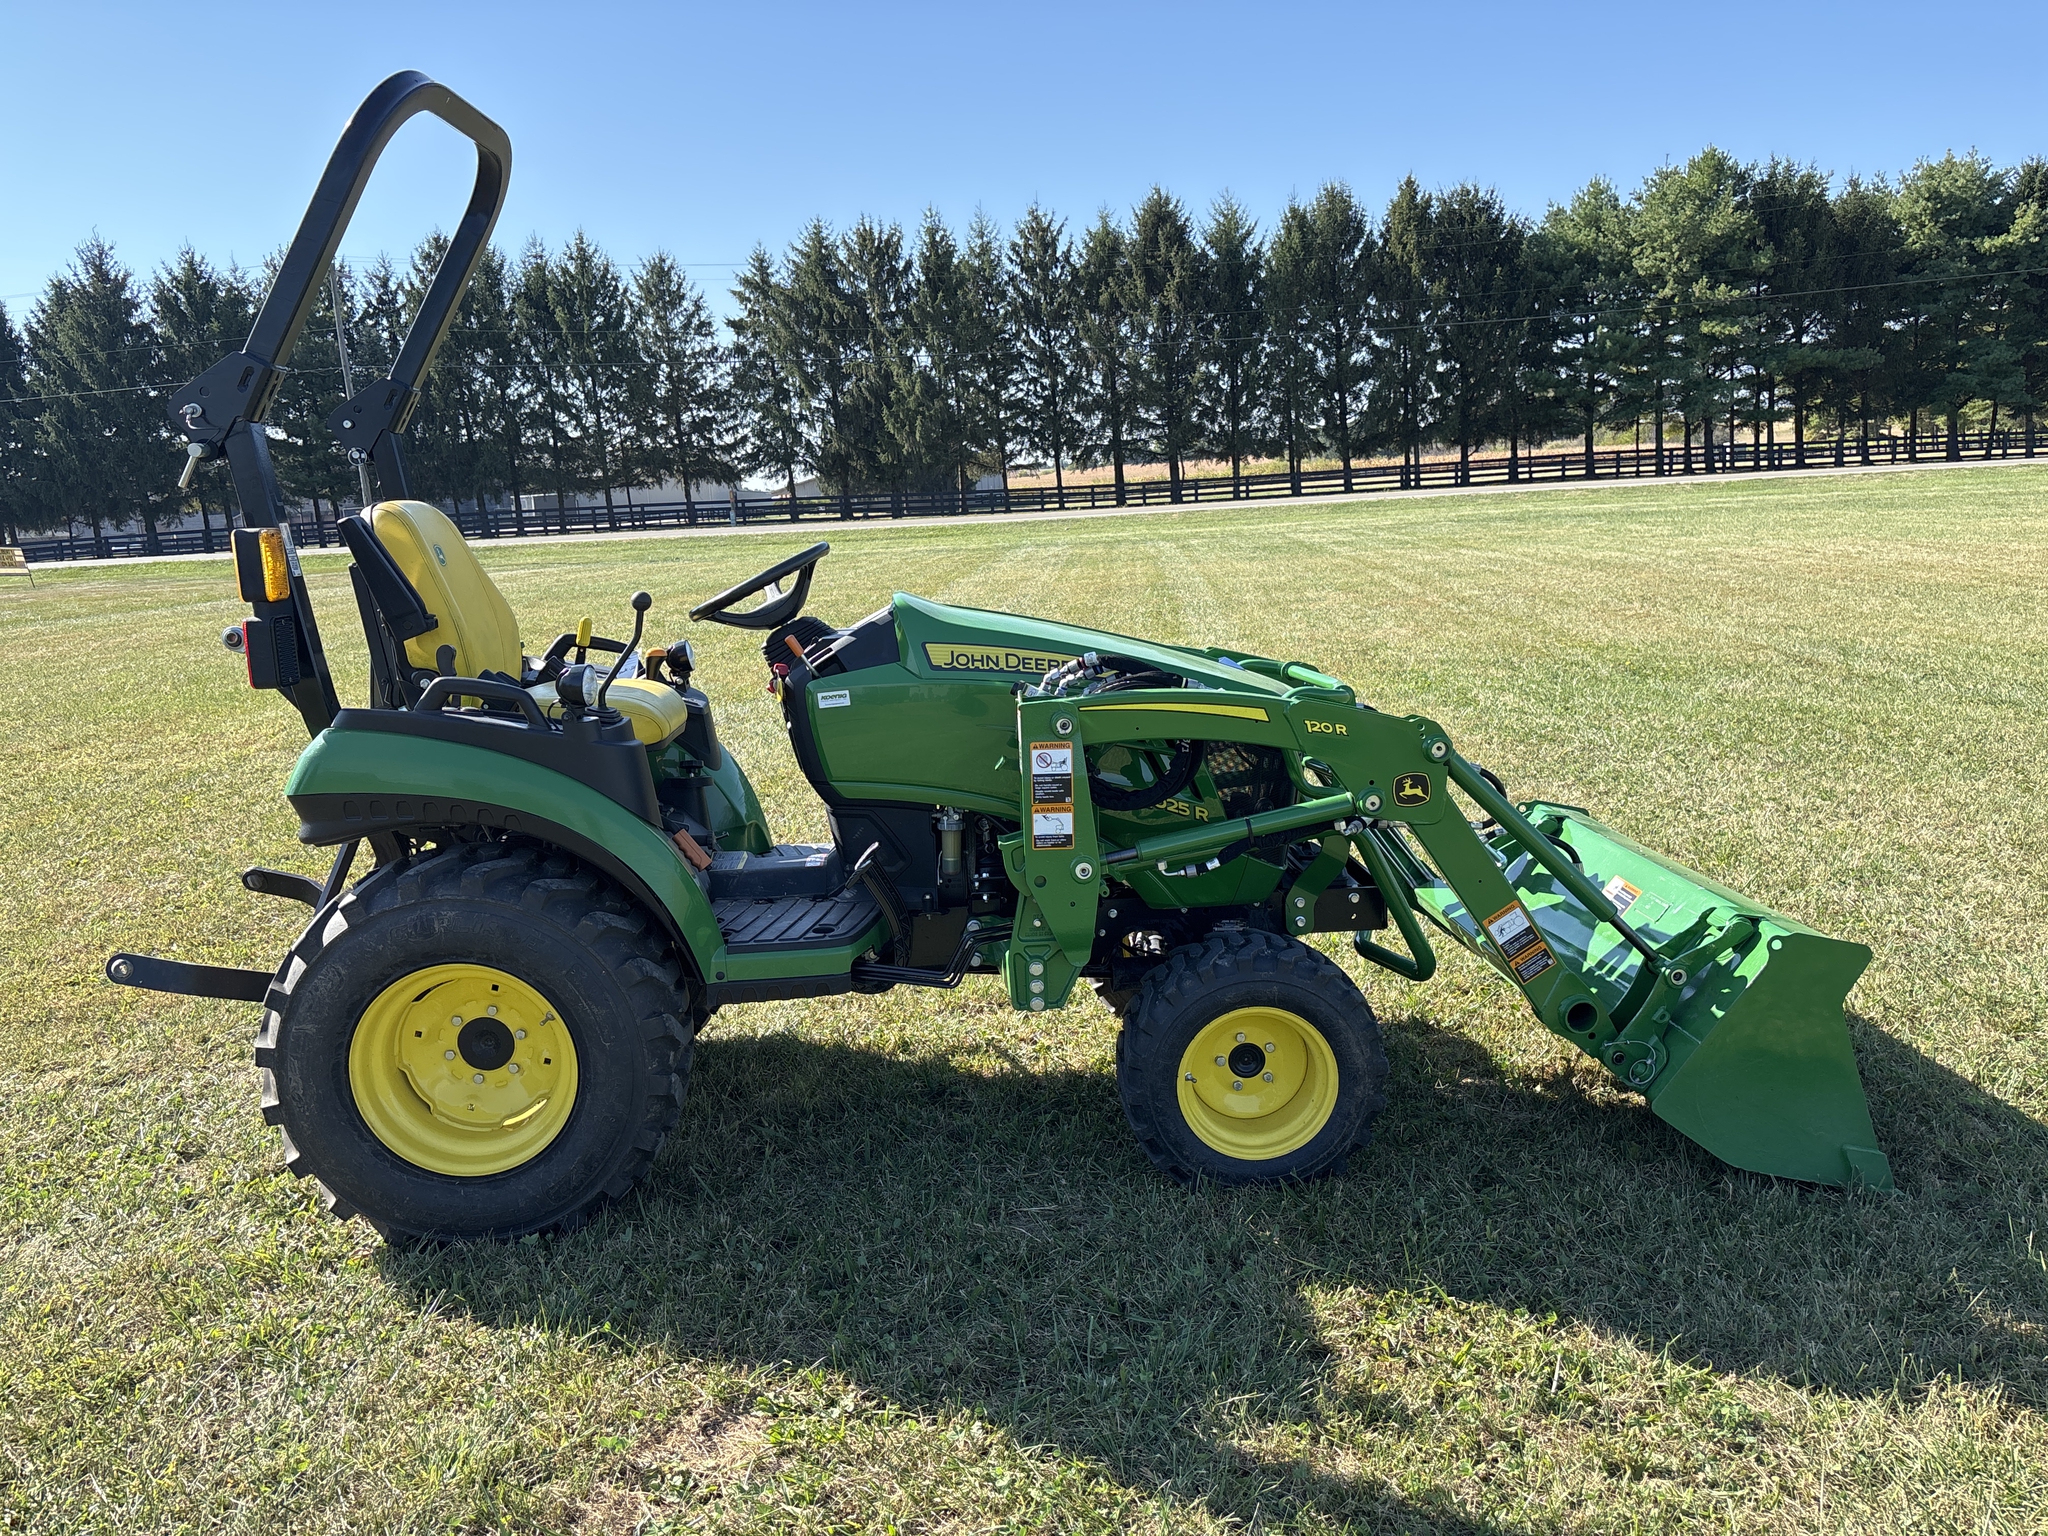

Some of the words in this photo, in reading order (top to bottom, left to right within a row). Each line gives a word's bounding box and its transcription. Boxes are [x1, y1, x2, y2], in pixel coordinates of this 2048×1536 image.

[944, 651, 999, 668] JOHN
[1304, 720, 1333, 733] 120
[1335, 723, 1348, 736] R
[1195, 806, 1208, 822] R
[1493, 904, 1516, 920] WARNING
[1520, 945, 1543, 962] WARNING
